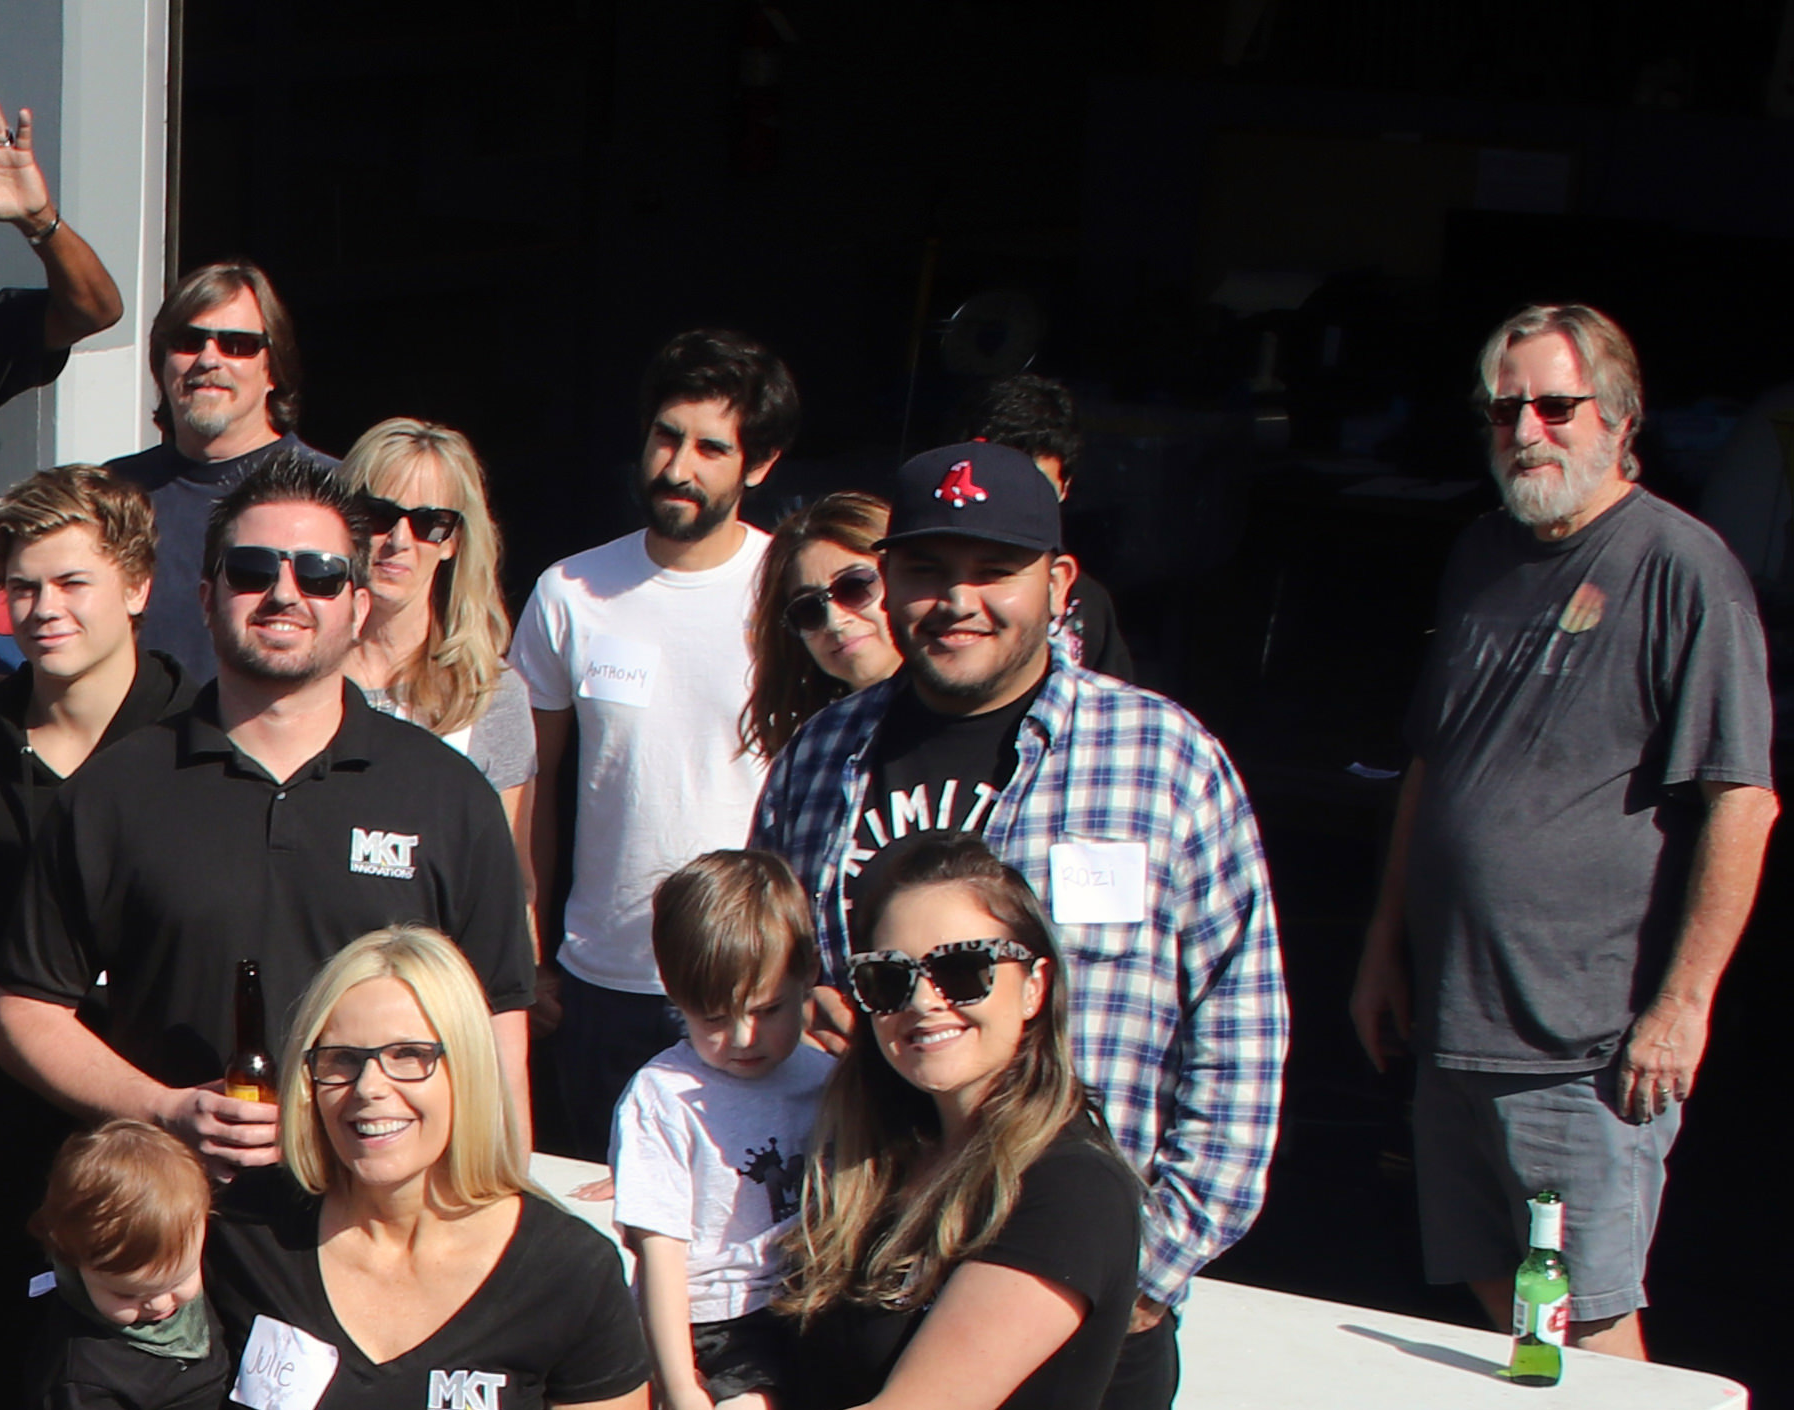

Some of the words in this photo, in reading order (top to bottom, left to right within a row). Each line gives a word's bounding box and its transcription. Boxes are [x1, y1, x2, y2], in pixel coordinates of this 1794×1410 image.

[586, 661, 649, 688] ANTHONY
[351, 827, 419, 867] MKT
[246, 1346, 295, 1388] Julie
